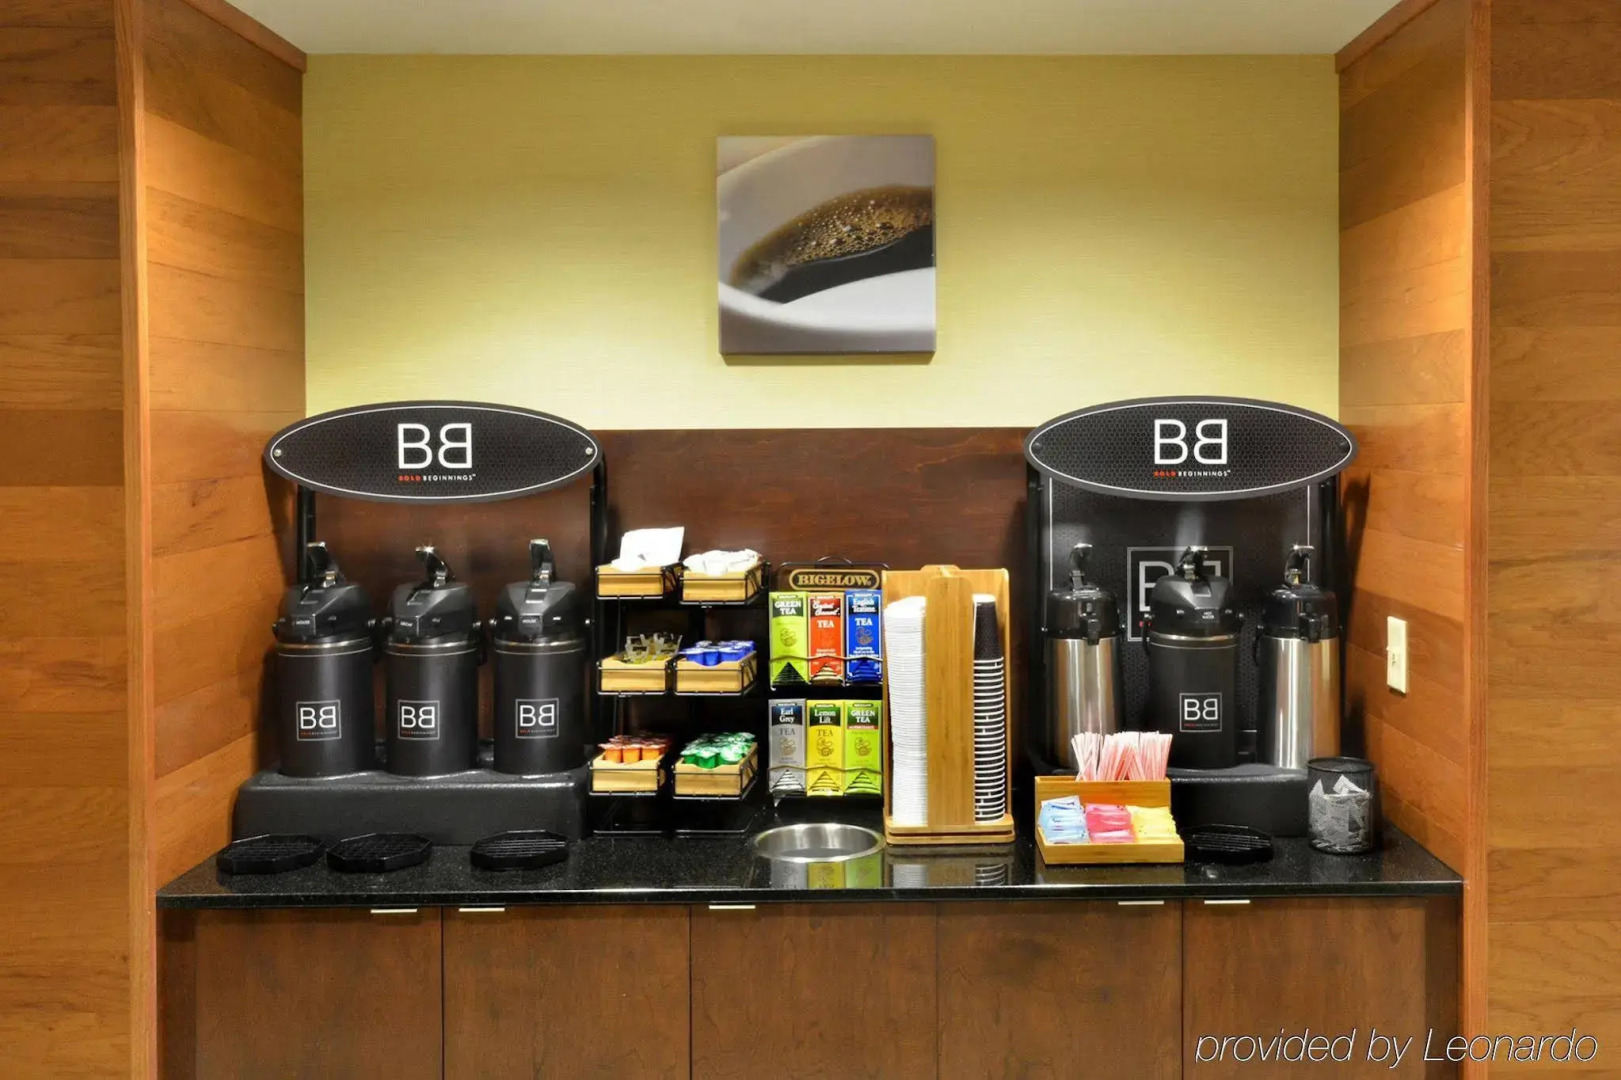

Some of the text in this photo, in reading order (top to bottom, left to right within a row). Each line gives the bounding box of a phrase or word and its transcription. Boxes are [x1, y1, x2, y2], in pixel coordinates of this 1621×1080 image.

[774, 600, 801, 608] GREEN
[817, 620, 835, 628] TEA
[854, 618, 873, 626] TEA
[780, 708, 794, 716] Earl
[850, 709, 876, 717] GREEN
[779, 715, 795, 724] Grey
[779, 728, 796, 736] TEA
